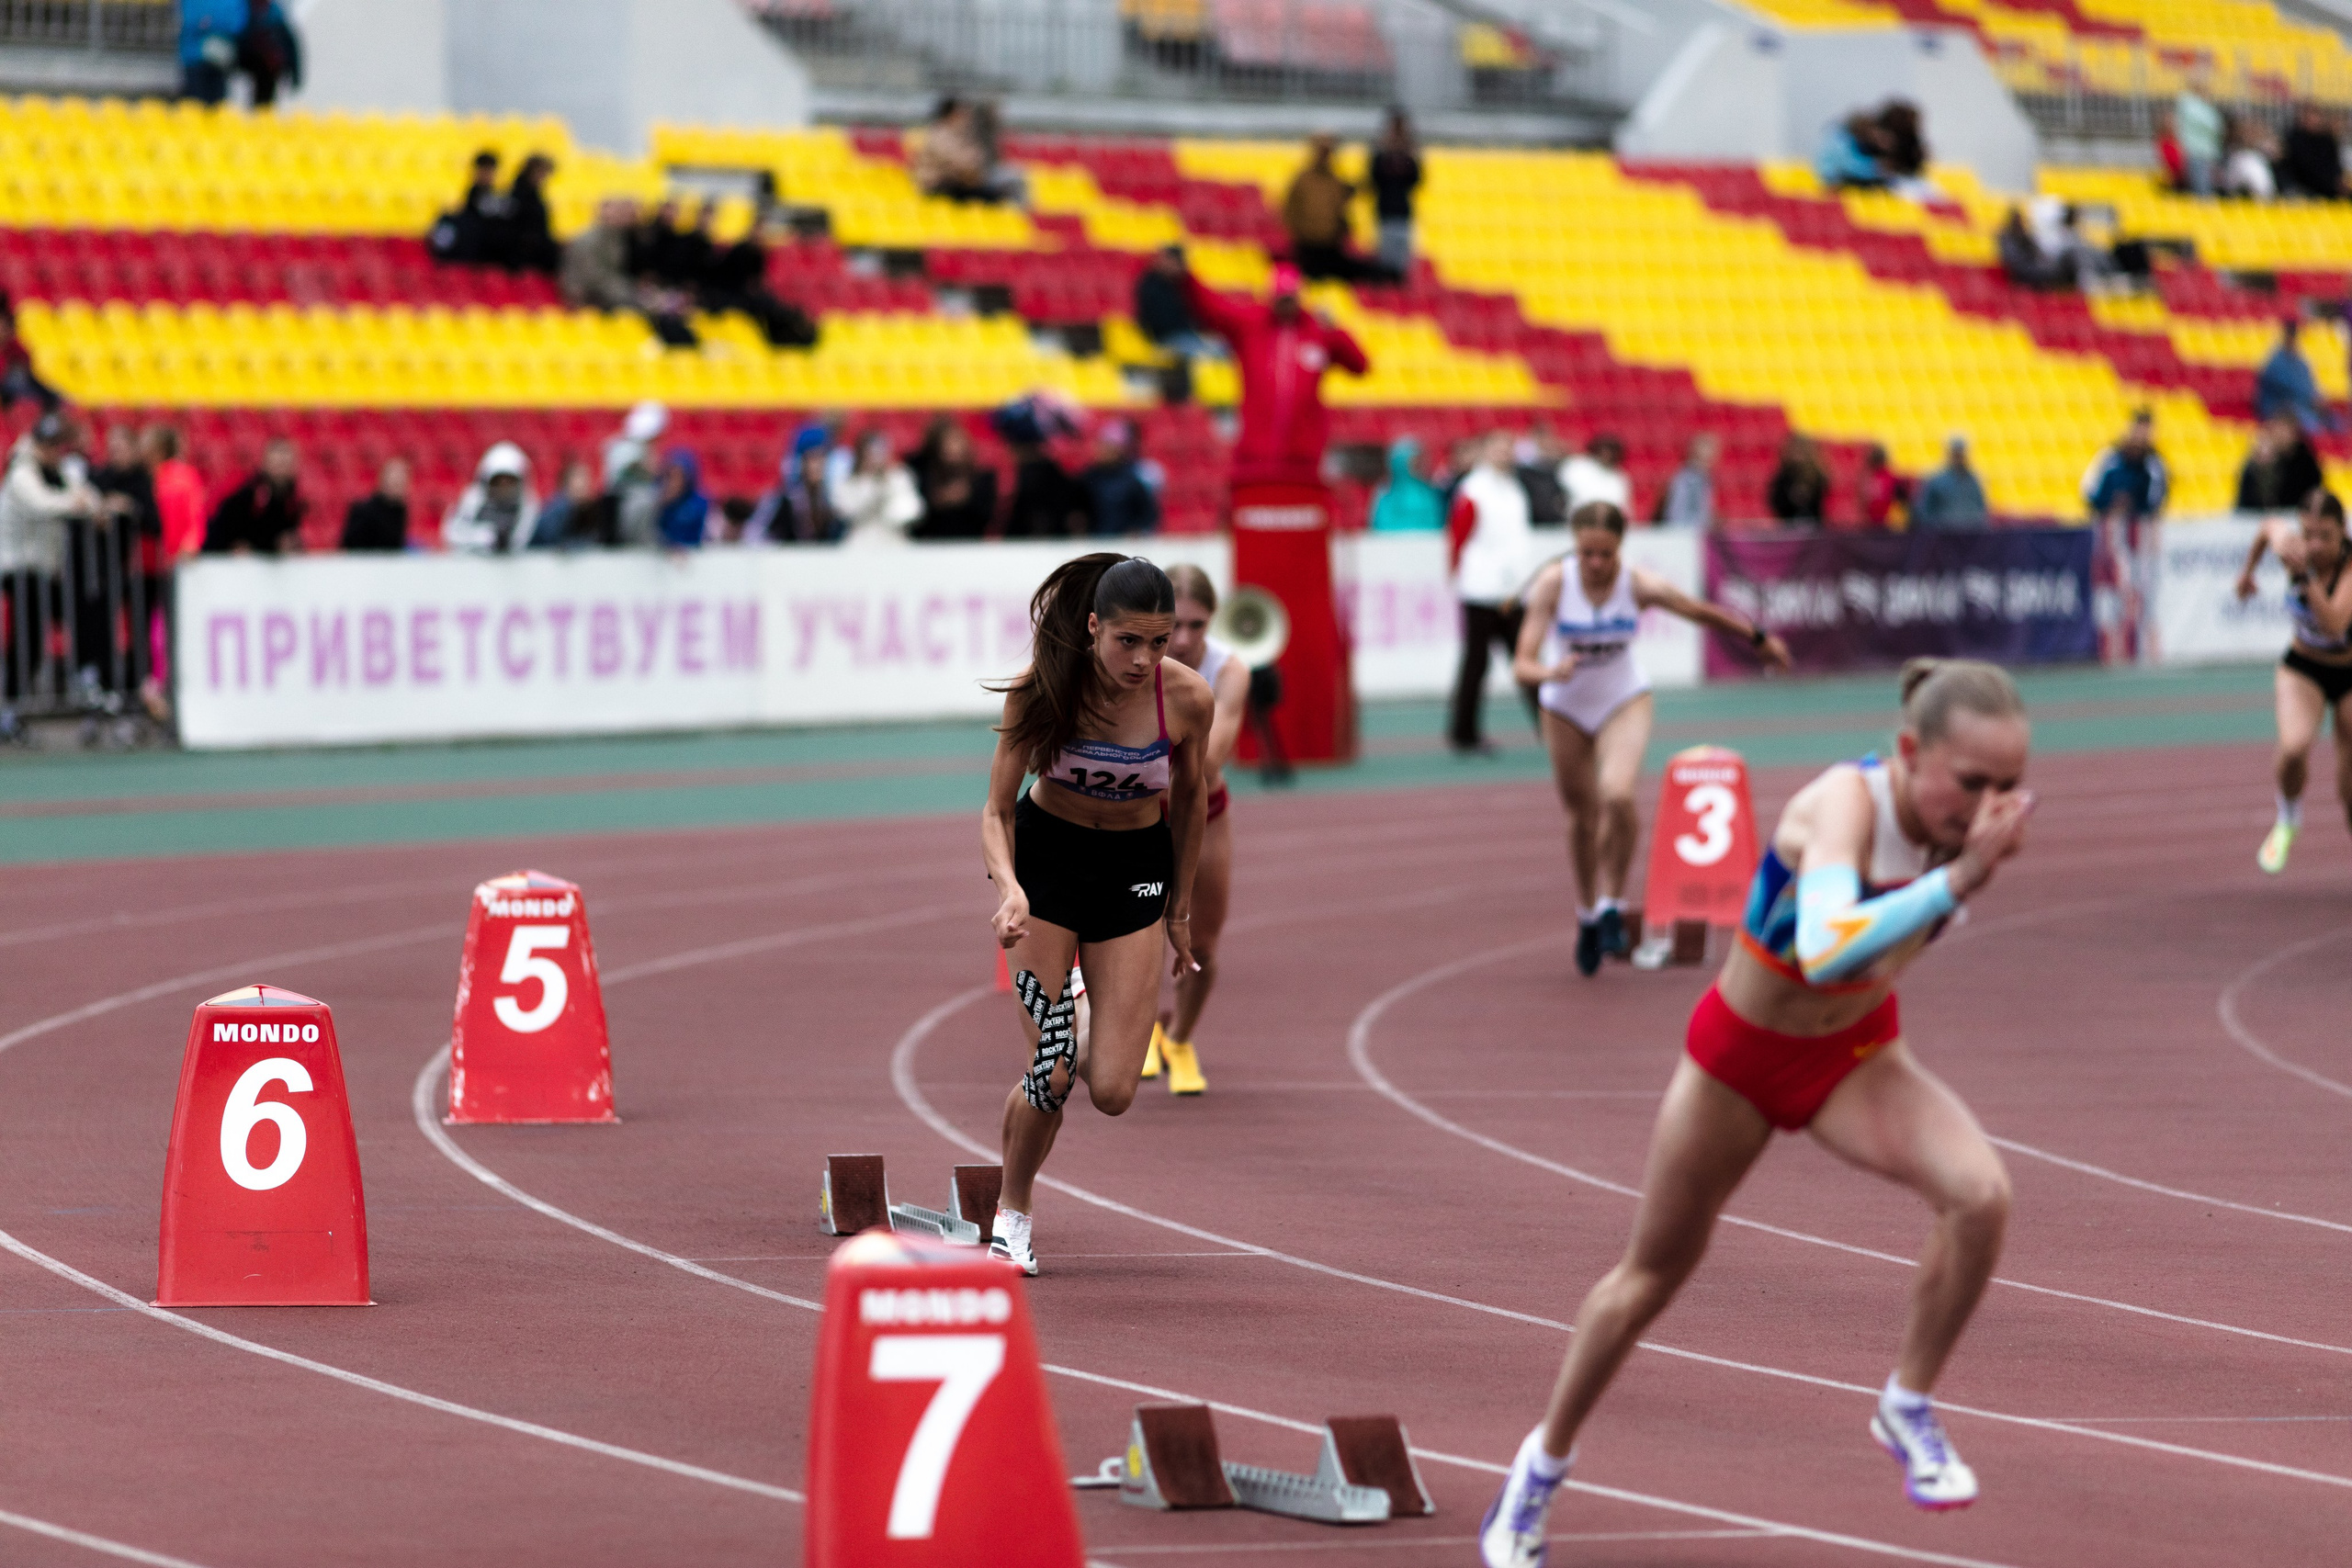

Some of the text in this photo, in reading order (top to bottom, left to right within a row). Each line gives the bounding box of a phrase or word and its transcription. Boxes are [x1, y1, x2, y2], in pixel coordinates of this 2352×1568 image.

[208, 593, 1032, 687] ПРИВЕТСТВУЕМ УЧАСТН
[1082, 745, 1140, 756] ПЕРВЕНСТВО
[1069, 767, 1148, 791] 124
[1091, 789, 1121, 800] ВФЛА
[1674, 784, 1737, 865] 3
[1130, 881, 1164, 897] RAY
[488, 897, 573, 918] MONDO
[493, 924, 571, 1033] 5
[212, 1023, 321, 1043] MONDO
[220, 1057, 313, 1190] 6
[859, 1288, 1011, 1325] MONDO
[869, 1335, 1007, 1540] 7
